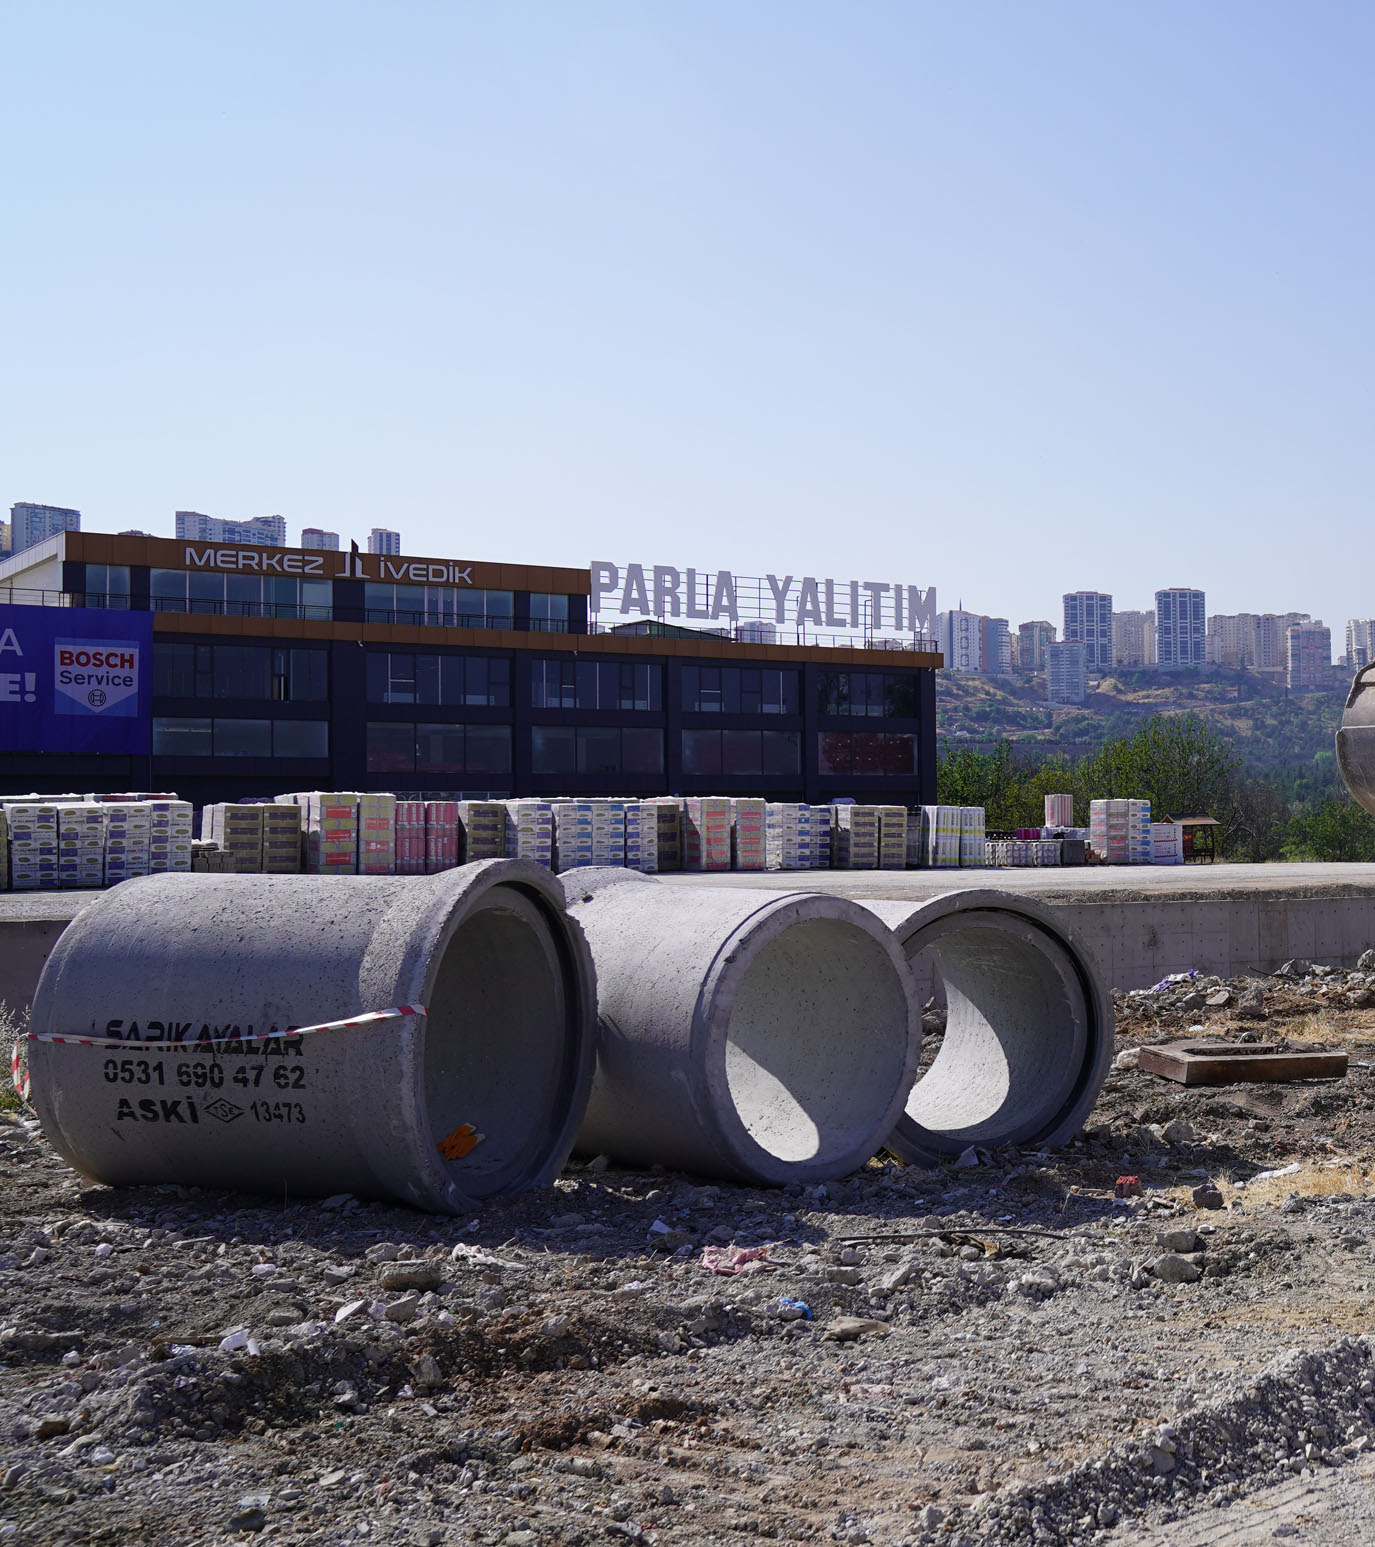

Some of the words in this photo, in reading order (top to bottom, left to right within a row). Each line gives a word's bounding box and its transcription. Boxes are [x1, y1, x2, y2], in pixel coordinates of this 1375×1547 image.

[185, 547, 324, 575] MERKEZ
[380, 556, 473, 584] İVEDİK
[590, 560, 739, 622] PARLA
[765, 573, 937, 633] YALITIM
[59, 650, 135, 669] BOSCH
[59, 670, 134, 687] Service
[103, 1058, 165, 1086] 0531
[176, 1062, 225, 1089] 690
[232, 1065, 265, 1088] 47
[273, 1065, 306, 1089] 62
[117, 1095, 200, 1124] ASKİ
[250, 1101, 306, 1123] 13473
